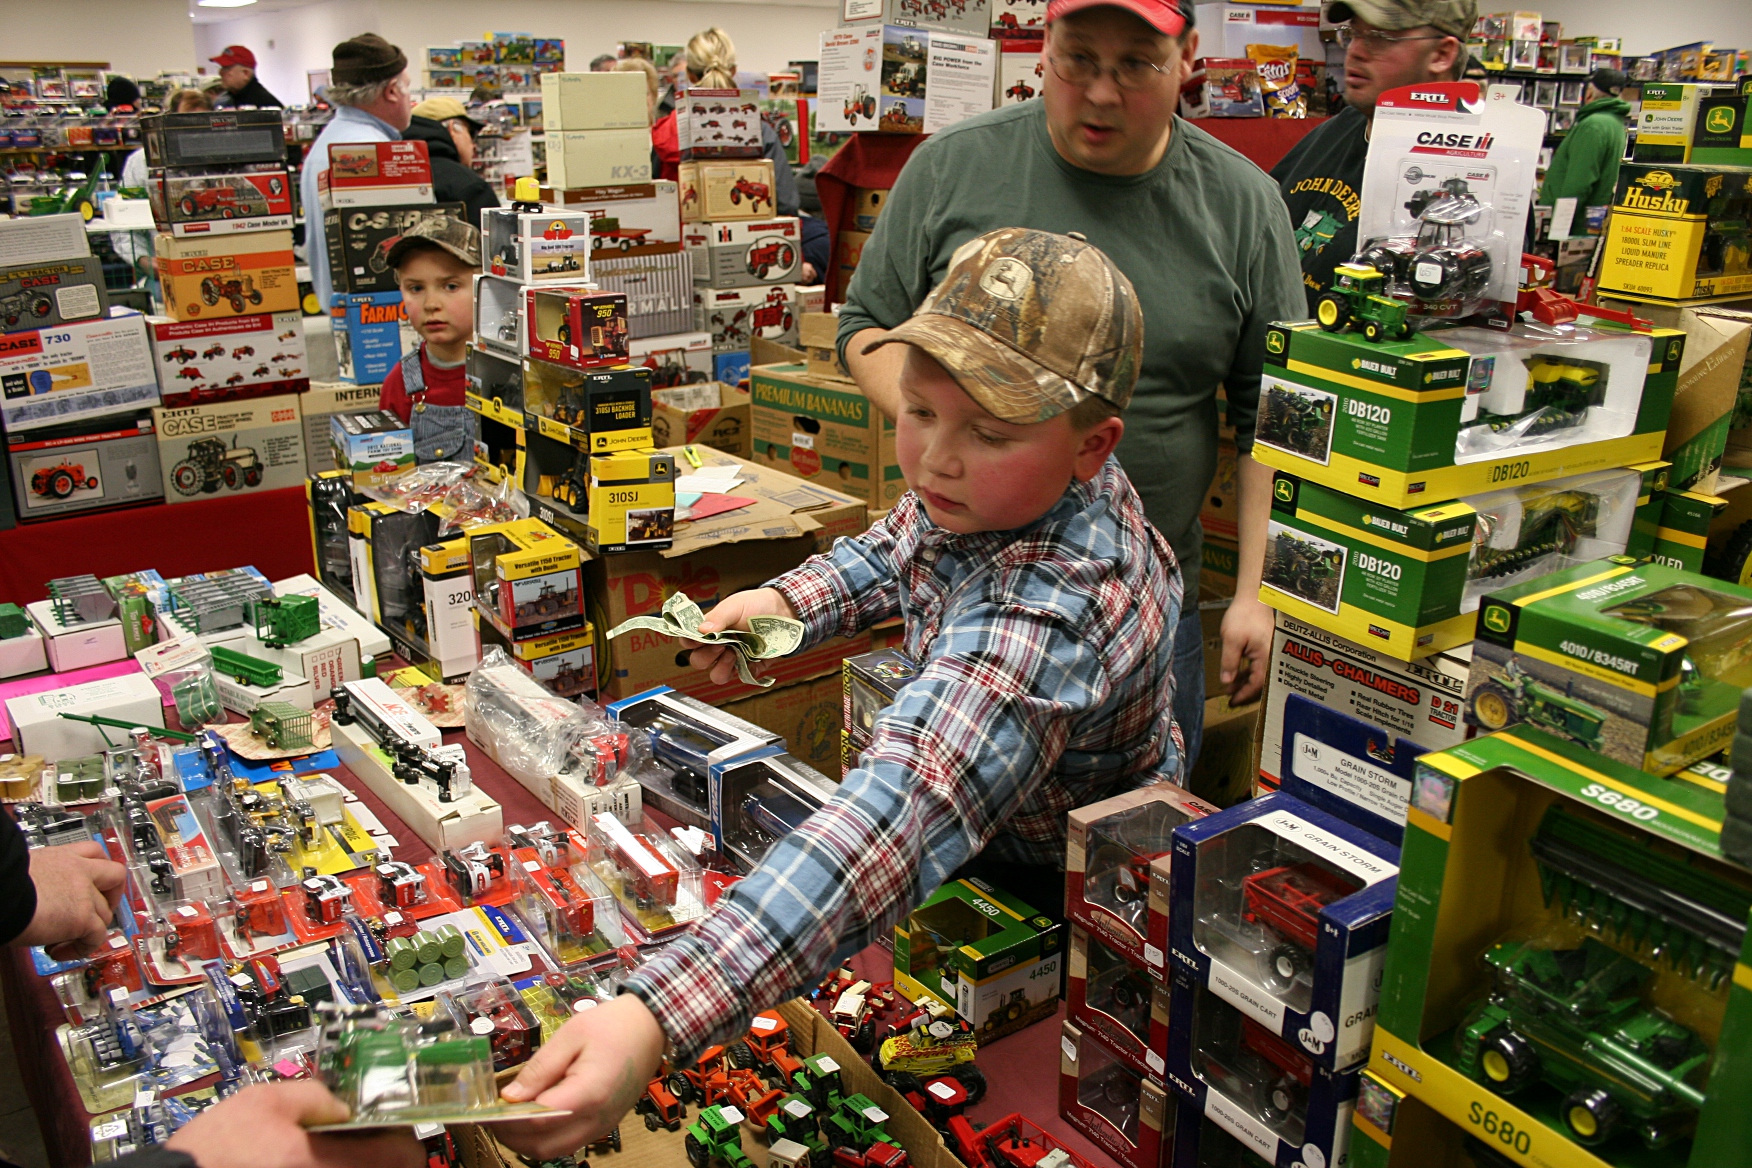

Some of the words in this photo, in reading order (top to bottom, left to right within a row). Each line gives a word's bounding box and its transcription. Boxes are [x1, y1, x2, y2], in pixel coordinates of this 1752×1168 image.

[895, 18, 916, 27] ERTL
[1257, 62, 1290, 80] Fritos
[1410, 92, 1449, 104] ERTL
[1417, 132, 1472, 148] CASE
[1475, 132, 1494, 150] IH
[611, 166, 649, 179] KX-3
[1290, 177, 1333, 194] JOHN
[1331, 179, 1361, 221] DEERE
[1622, 186, 1690, 217] Husky
[1621, 225, 1632, 234] 1:64
[1634, 227, 1651, 236] SCALE
[1621, 237, 1640, 246] 18000L
[1642, 239, 1656, 247] SLIM
[1658, 241, 1672, 249] LINE
[1622, 247, 1640, 256] LIQUID
[1642, 250, 1667, 260] MANURE
[27, 267, 66, 275] TRACTOR
[182, 257, 235, 273] CASE
[1615, 258, 1643, 268] SPREADER
[1645, 261, 1669, 271] REPLICA
[21, 275, 59, 288] CASE
[1637, 285, 1653, 293] 40093
[360, 302, 397, 324] FARM
[596, 309, 612, 318] 950
[628, 296, 690, 316] RMALL
[0, 338, 38, 350] CASE
[45, 333, 71, 345] 730
[1361, 360, 1379, 371] BAUER
[1381, 364, 1397, 376] BUILT
[1707, 348, 1736, 372] Edition
[1433, 371, 1446, 380] BAUER
[1448, 369, 1461, 378] BUILT
[336, 388, 380, 402] INTERN
[756, 383, 806, 406] PREMIUM
[807, 394, 863, 420] BANANAS
[162, 408, 200, 418] ERTL
[1348, 399, 1390, 424] DB120
[163, 415, 217, 436] CASE
[1492, 461, 1529, 483] DB120
[608, 491, 638, 504] 310SJ
[1371, 516, 1390, 530] BAUER
[1391, 522, 1408, 535] BUILT
[515, 560, 539, 570] Versatile
[554, 554, 572, 563] Tractor
[1358, 553, 1401, 580] DB120
[622, 562, 720, 616] Dole
[1284, 620, 1331, 644] DEUTZ-ALLIS
[1332, 639, 1376, 662] Corporation
[312, 665, 320, 690] SILVER
[328, 660, 336, 688] ORANGE
[1284, 671, 1302, 682] Highly
[1304, 678, 1327, 694] Detailed
[1286, 663, 1310, 678] Knuckle
[1310, 672, 1334, 689] Steering
[1406, 661, 1464, 693] ERTL
[1283, 679, 1307, 693] Die-Cast
[1308, 688, 1324, 701] Metal
[383, 703, 407, 714] ACE
[1357, 700, 1370, 711] Rear
[1372, 706, 1389, 719] Hitch
[1390, 713, 1400, 723] for
[1402, 718, 1414, 729] 1/16
[1358, 692, 1372, 703] Real
[1373, 698, 1396, 713] Rubber
[1397, 706, 1414, 720] Tires
[1430, 707, 1457, 724] TRACTOR
[1432, 696, 1440, 708] D
[1445, 700, 1459, 715] 21
[1355, 708, 1372, 720] Scale
[1374, 716, 1412, 736] Implements
[1302, 745, 1318, 759] J&M
[1335, 766, 1352, 779] Model
[1353, 774, 1380, 791] 1000-20S
[1381, 787, 1397, 799] Grain
[1340, 758, 1366, 775] GRAIN
[1368, 770, 1397, 790] STORM
[1340, 776, 1363, 792] Capacity
[1327, 780, 1336, 788] Low
[1337, 783, 1355, 797] Profile
[1359, 794, 1378, 808] Narrow
[1379, 803, 1405, 819] Transport
[1369, 790, 1385, 803] Single
[1581, 783, 1659, 820] S680
[1304, 833, 1339, 852] GRAIN
[1339, 850, 1383, 874] STORM
[1152, 872, 1170, 885] ERTL
[973, 898, 1000, 916] 4450
[1074, 912, 1094, 930] Magnum
[1109, 934, 1126, 950] Tractor
[1130, 949, 1152, 967] Tracteur
[1171, 948, 1199, 970] ERTL
[1029, 960, 1056, 981] 4450
[1215, 976, 1239, 996] 1000-20S
[1240, 994, 1260, 1008] GRAIN
[1260, 1005, 1277, 1019] CART
[1300, 1031, 1320, 1047] J&M
[1383, 1052, 1422, 1083] ERTL
[1169, 1072, 1195, 1098] ERTL
[1211, 1104, 1234, 1124] 1000-20S
[1235, 1119, 1254, 1138] GRAIN
[1254, 1135, 1271, 1150] CART
[1468, 1101, 1531, 1155] S680
